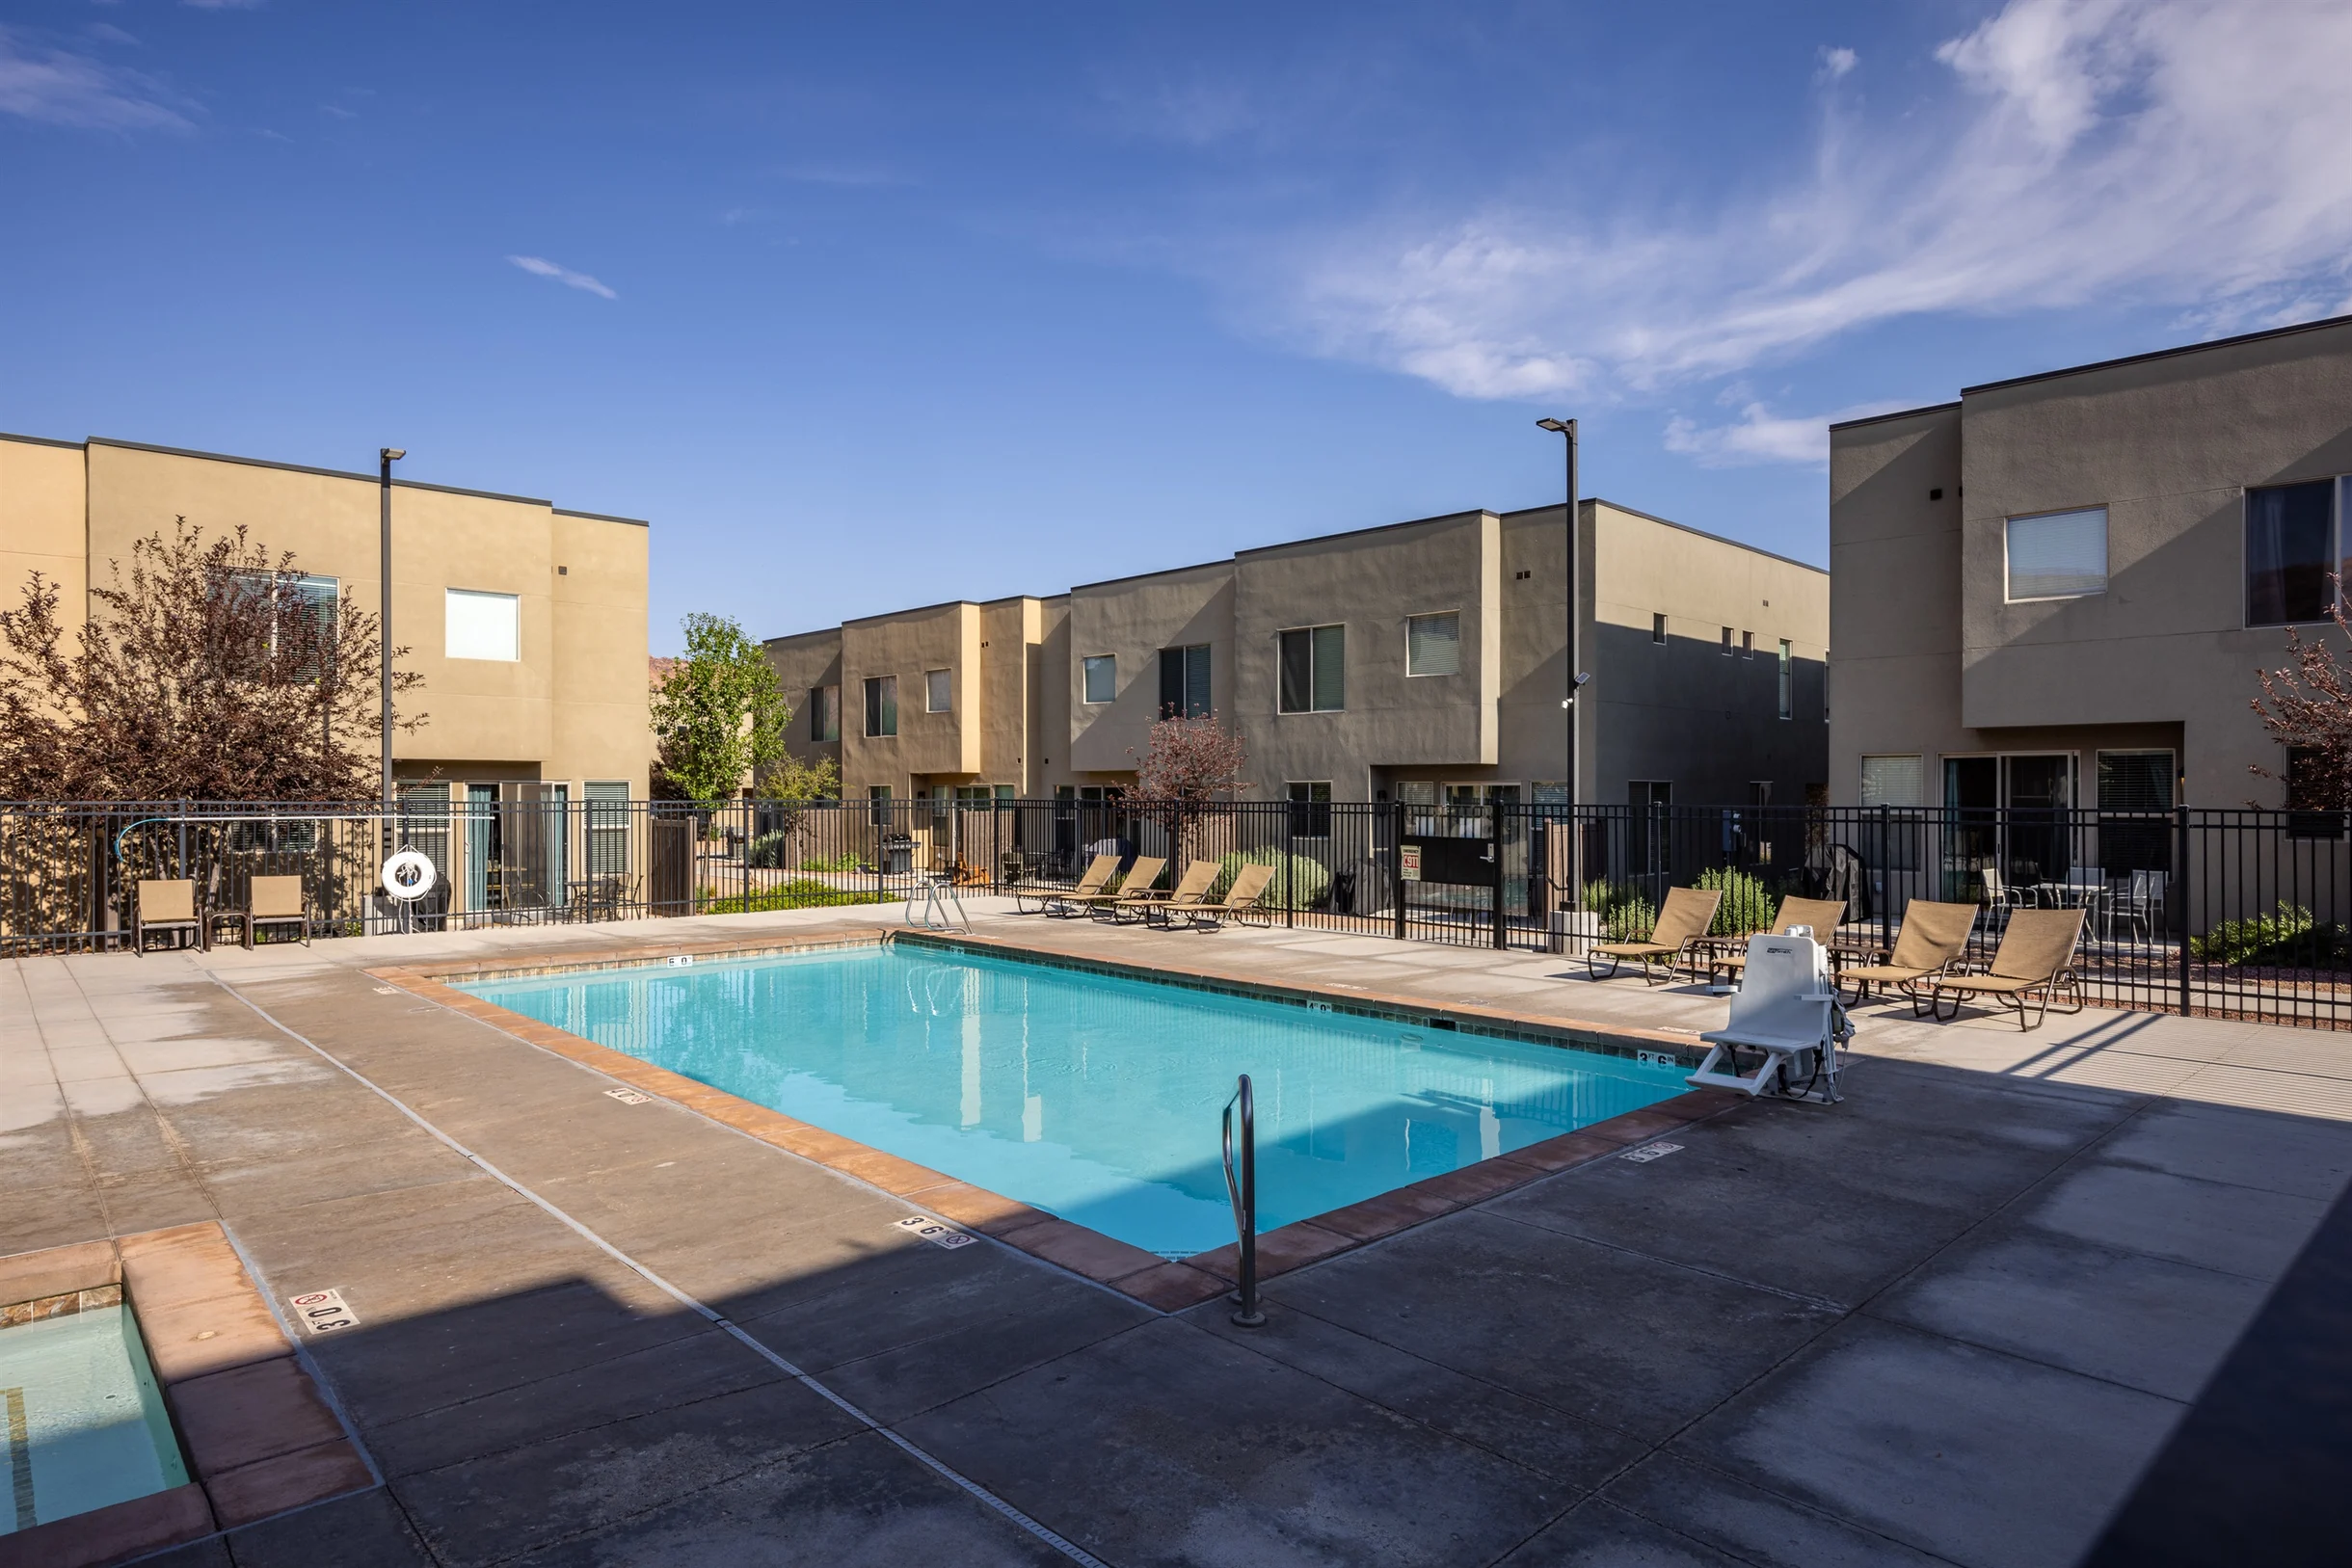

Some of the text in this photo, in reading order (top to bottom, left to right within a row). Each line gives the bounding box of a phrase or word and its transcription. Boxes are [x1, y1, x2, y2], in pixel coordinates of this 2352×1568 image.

[1407, 856, 1419, 867] 911
[901, 1217, 925, 1226] 3
[920, 1226, 945, 1235] 6
